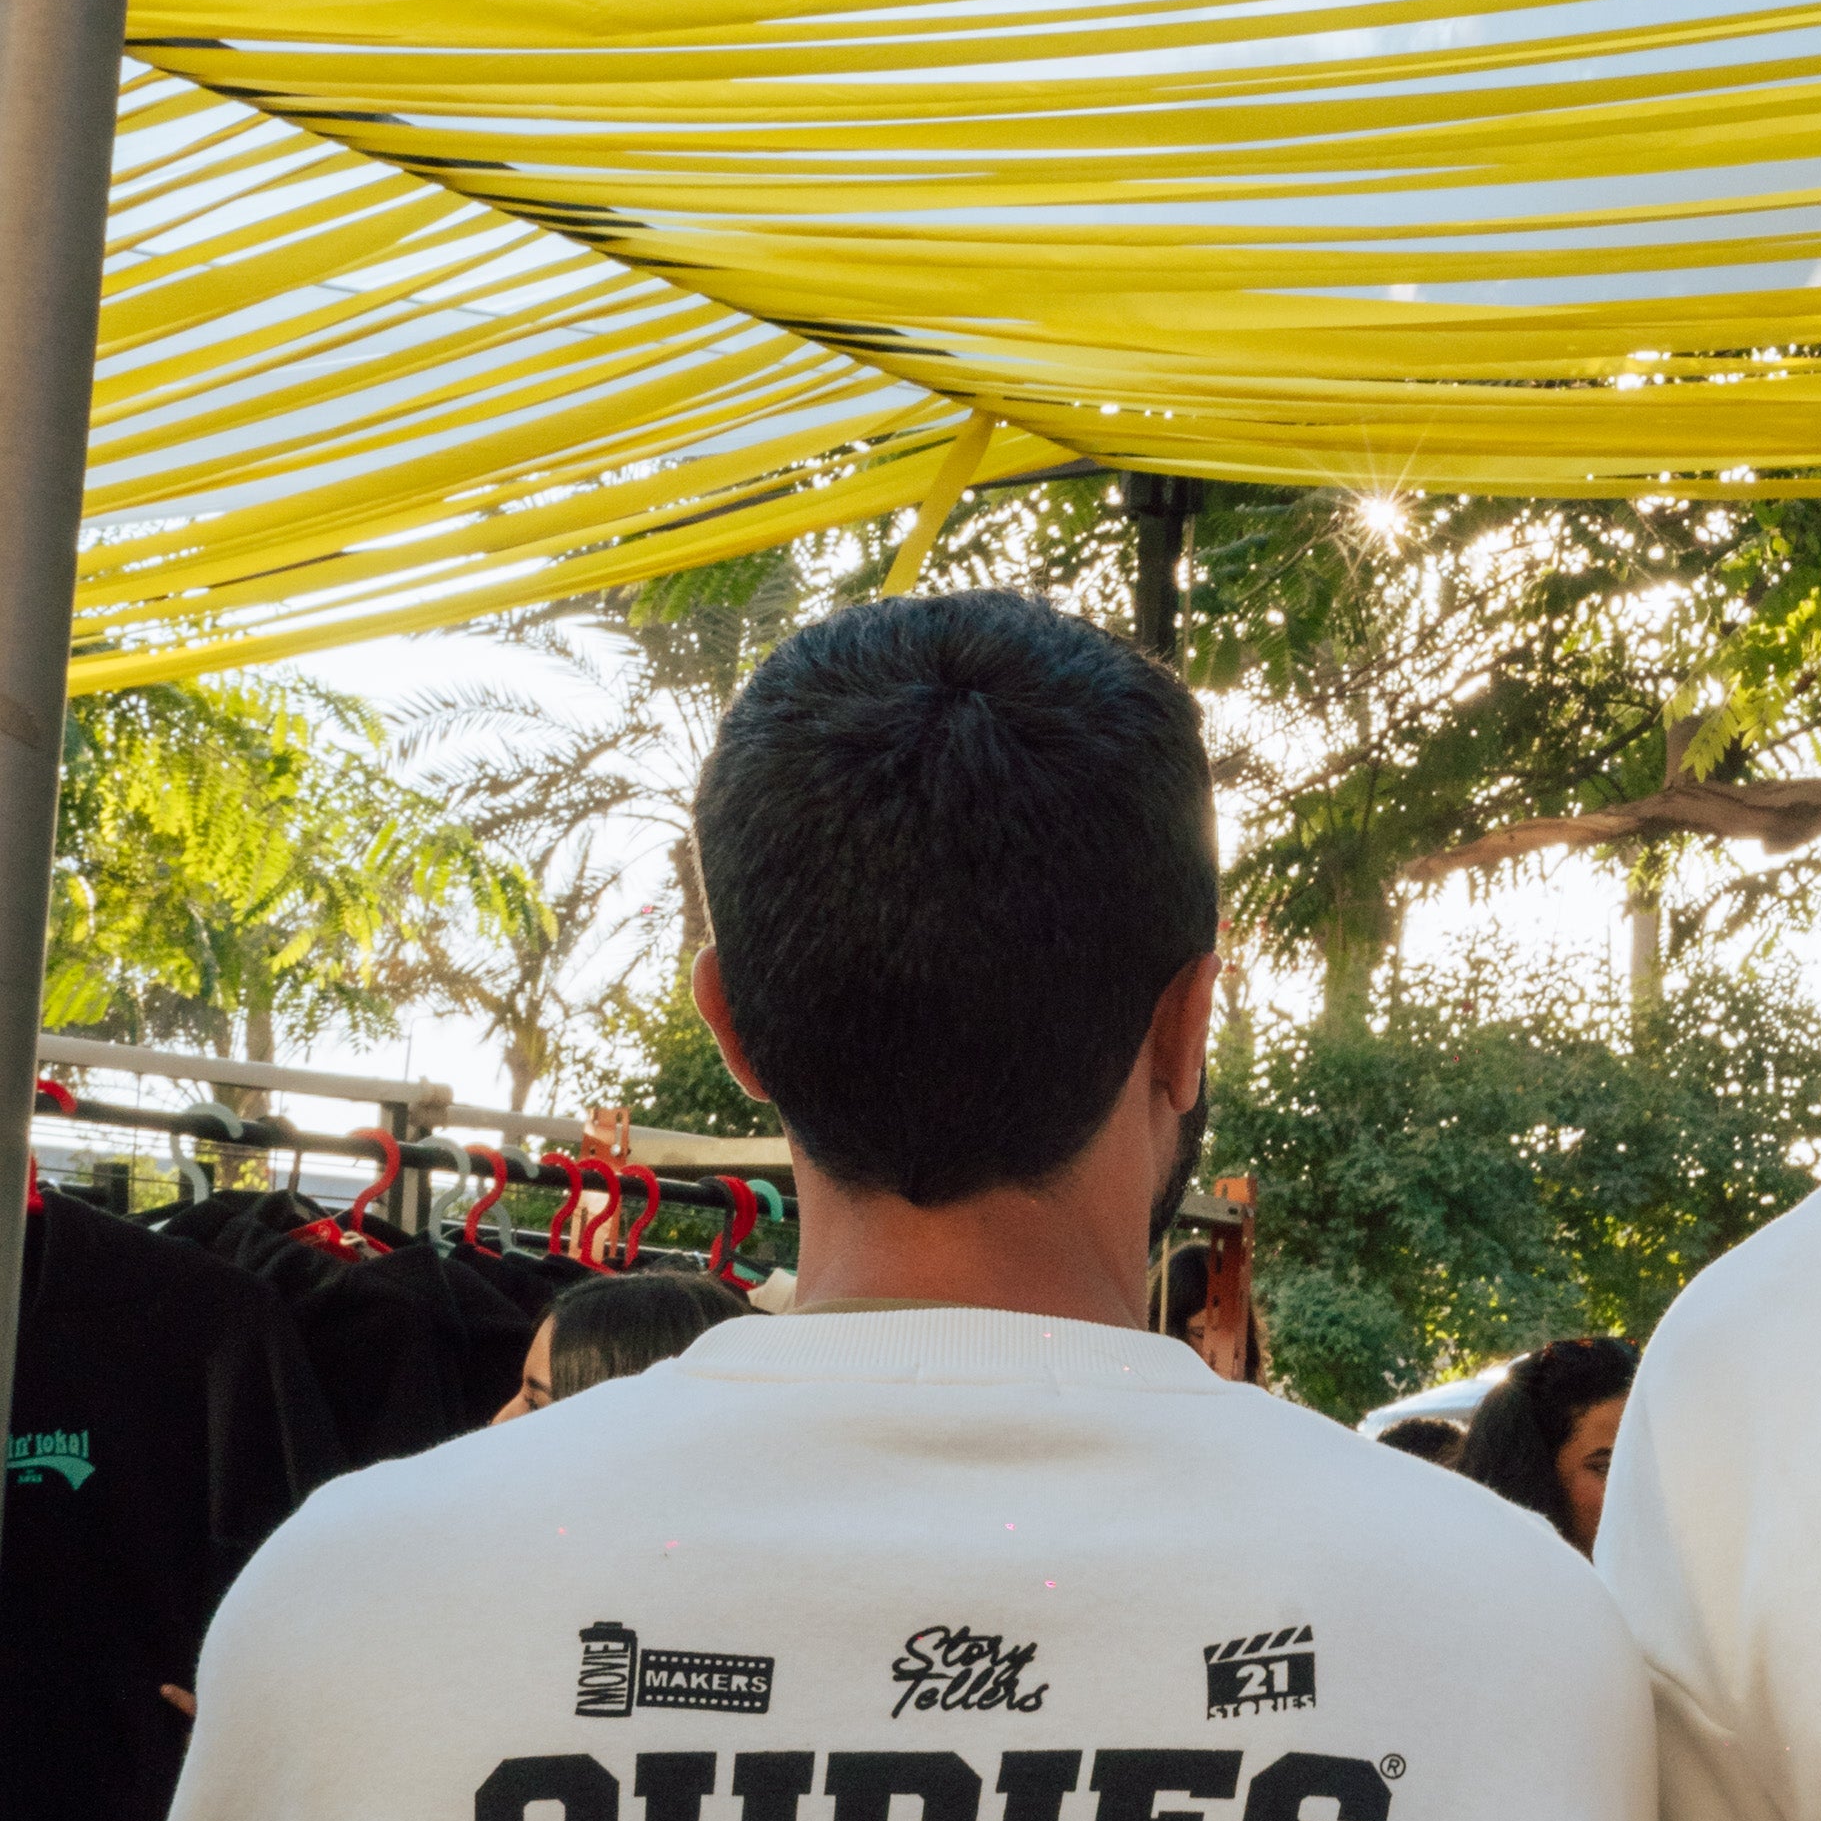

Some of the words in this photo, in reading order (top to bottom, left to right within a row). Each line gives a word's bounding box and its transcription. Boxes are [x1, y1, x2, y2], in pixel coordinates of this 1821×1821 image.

[577, 1642, 629, 1708] MOVIE
[892, 1625, 1038, 1689] Story
[1235, 1659, 1289, 1698] 21
[645, 1669, 768, 1694] MAKERS
[891, 1666, 1050, 1719] Tellers
[1209, 1694, 1315, 1720] STORIES
